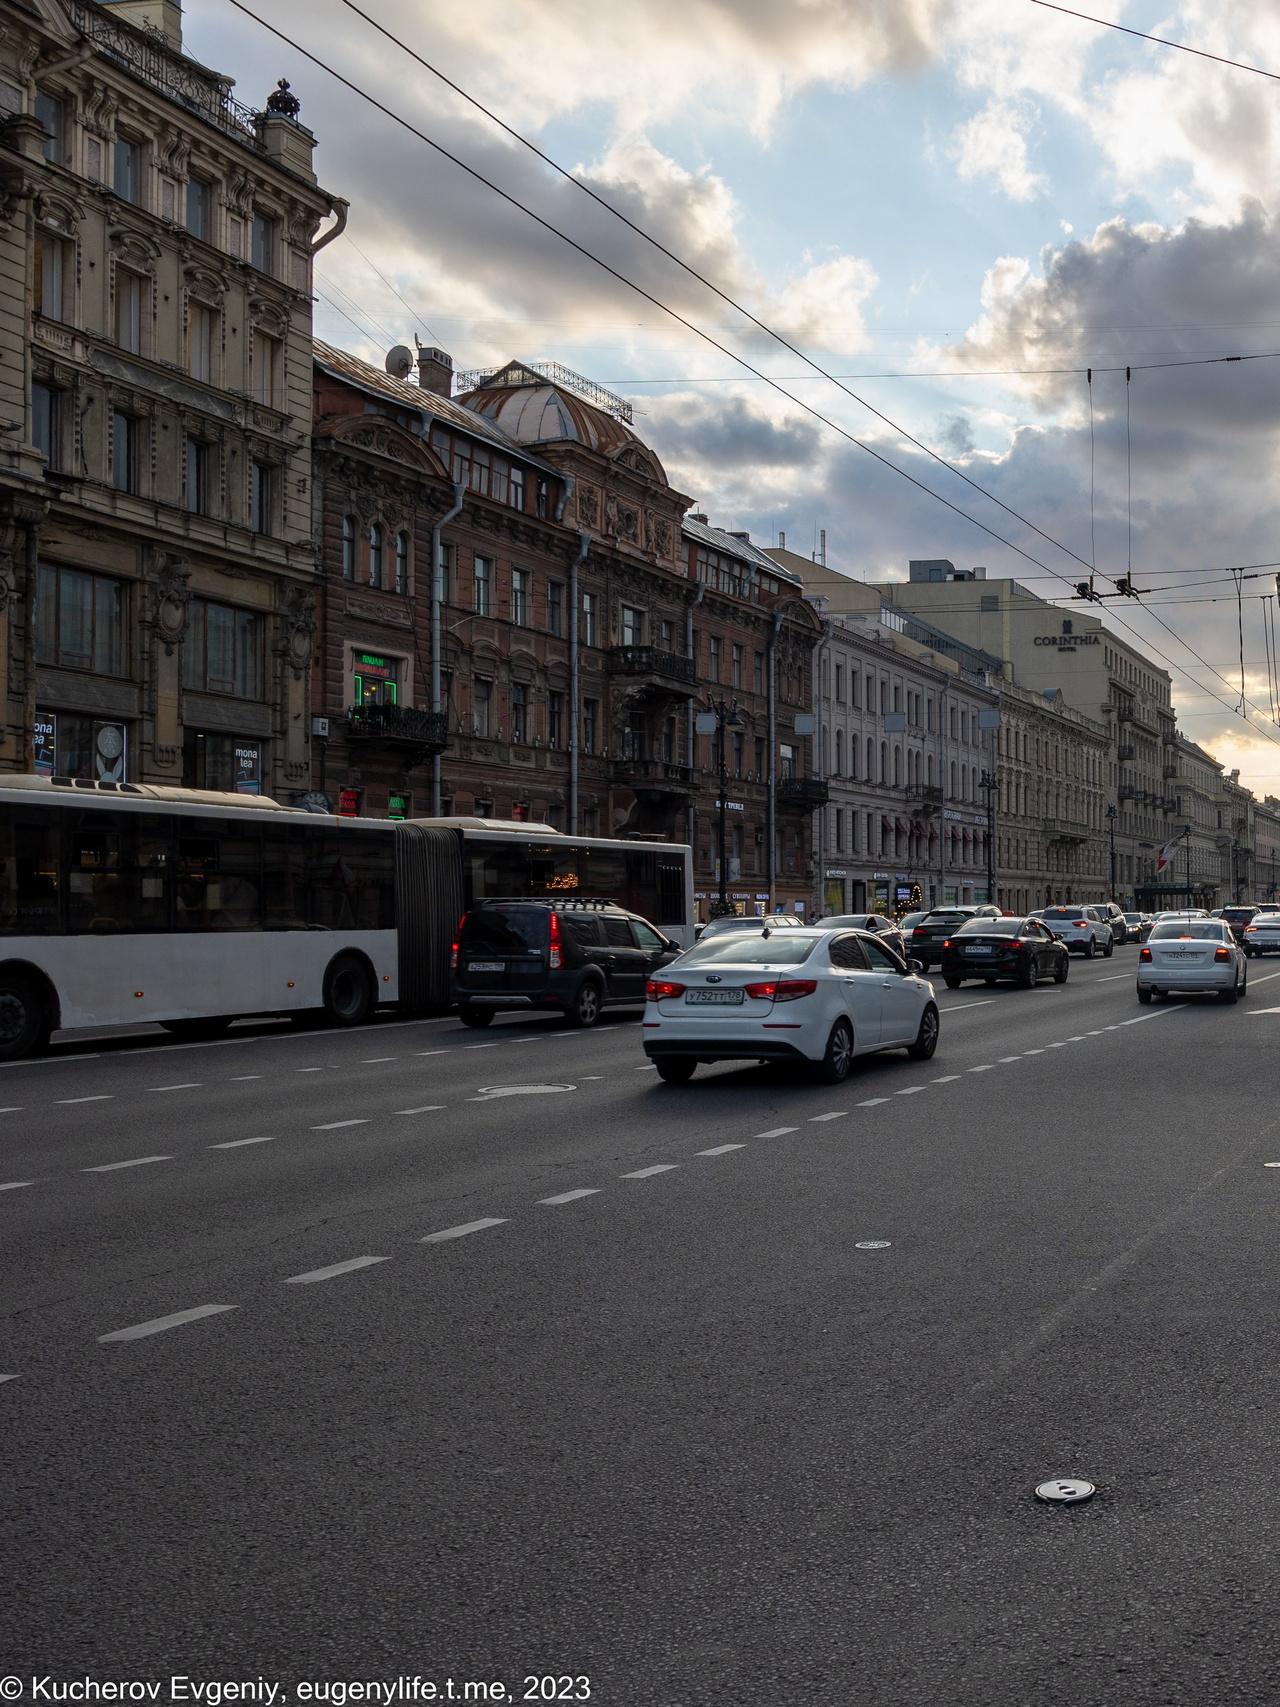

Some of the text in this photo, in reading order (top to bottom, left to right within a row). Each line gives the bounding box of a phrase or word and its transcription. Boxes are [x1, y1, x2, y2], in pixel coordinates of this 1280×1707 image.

[1034, 636, 1101, 646] CORINTHIA
[236, 748, 258, 758] mona
[240, 757, 252, 768] tea
[690, 992, 724, 1000] У752ТТ
